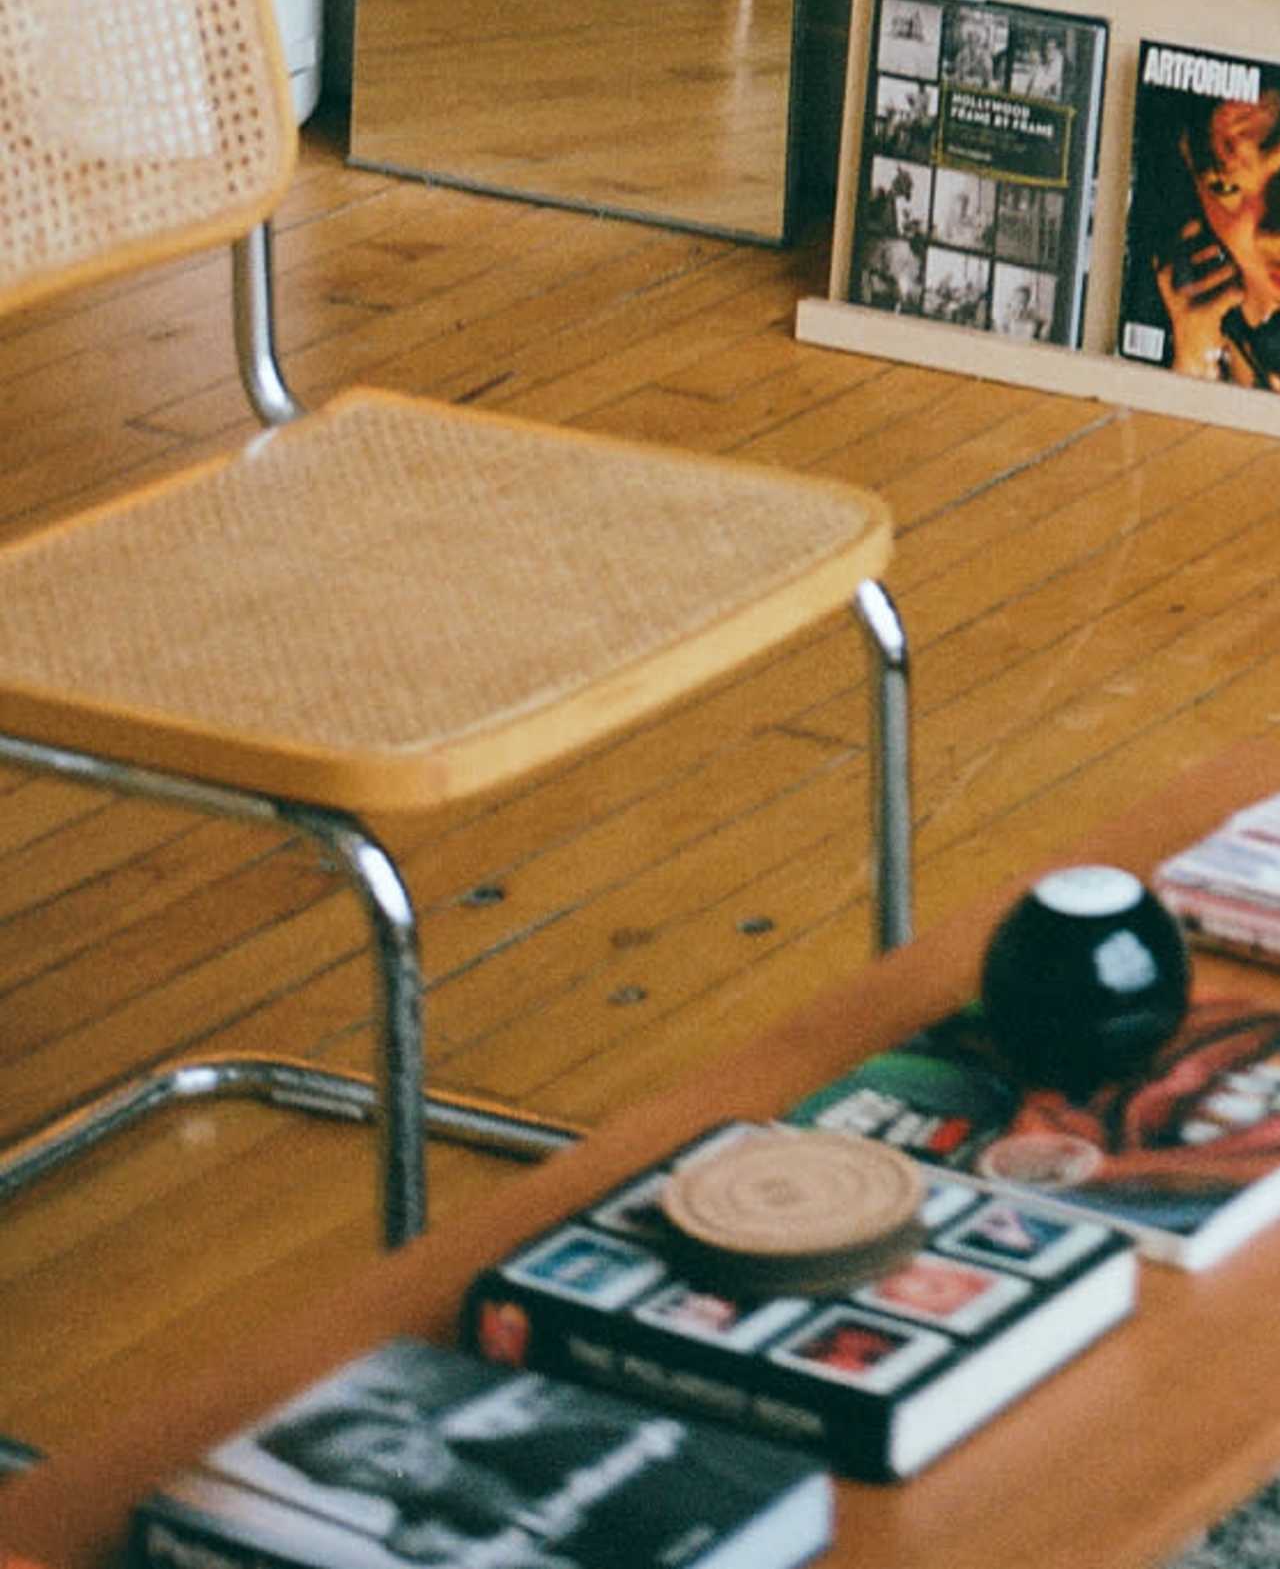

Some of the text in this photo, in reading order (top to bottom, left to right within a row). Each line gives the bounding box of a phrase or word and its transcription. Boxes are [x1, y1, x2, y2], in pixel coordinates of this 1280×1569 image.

[1143, 46, 1261, 105] ARTFORUM
[951, 92, 1031, 119] HOLLYWOOD
[950, 106, 1054, 138] FRAME BY FRAME
